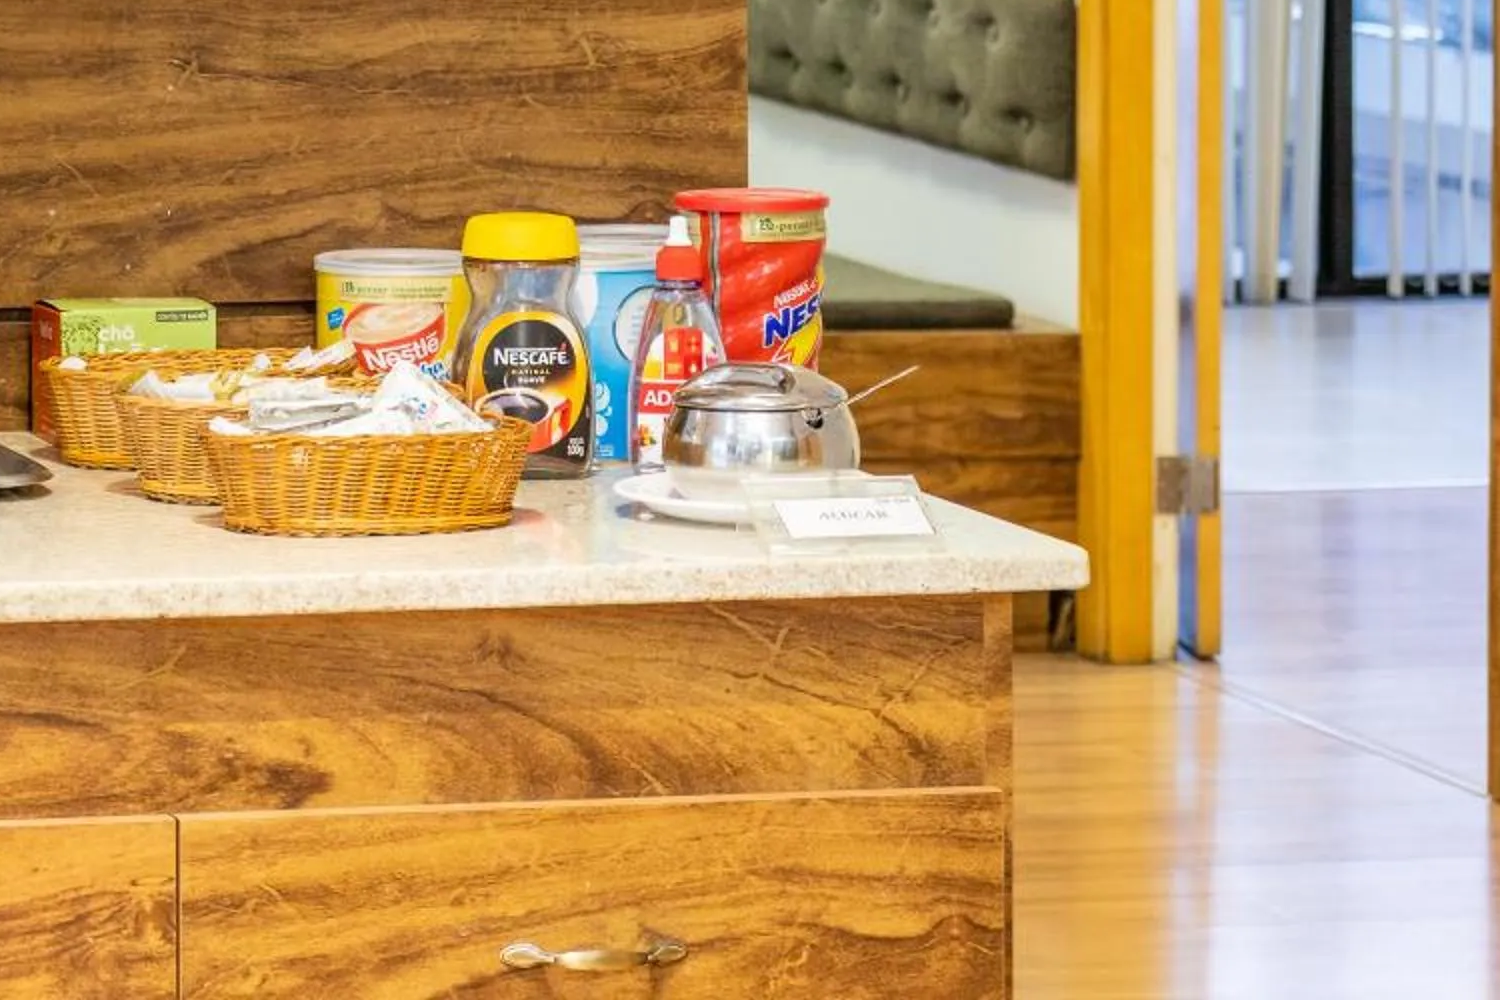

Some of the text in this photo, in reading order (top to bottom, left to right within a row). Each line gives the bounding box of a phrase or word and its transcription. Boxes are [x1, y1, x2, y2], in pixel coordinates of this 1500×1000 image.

[360, 331, 441, 372] Nestlé
[493, 341, 571, 366] NESCAFÉ
[643, 389, 674, 407] AD
